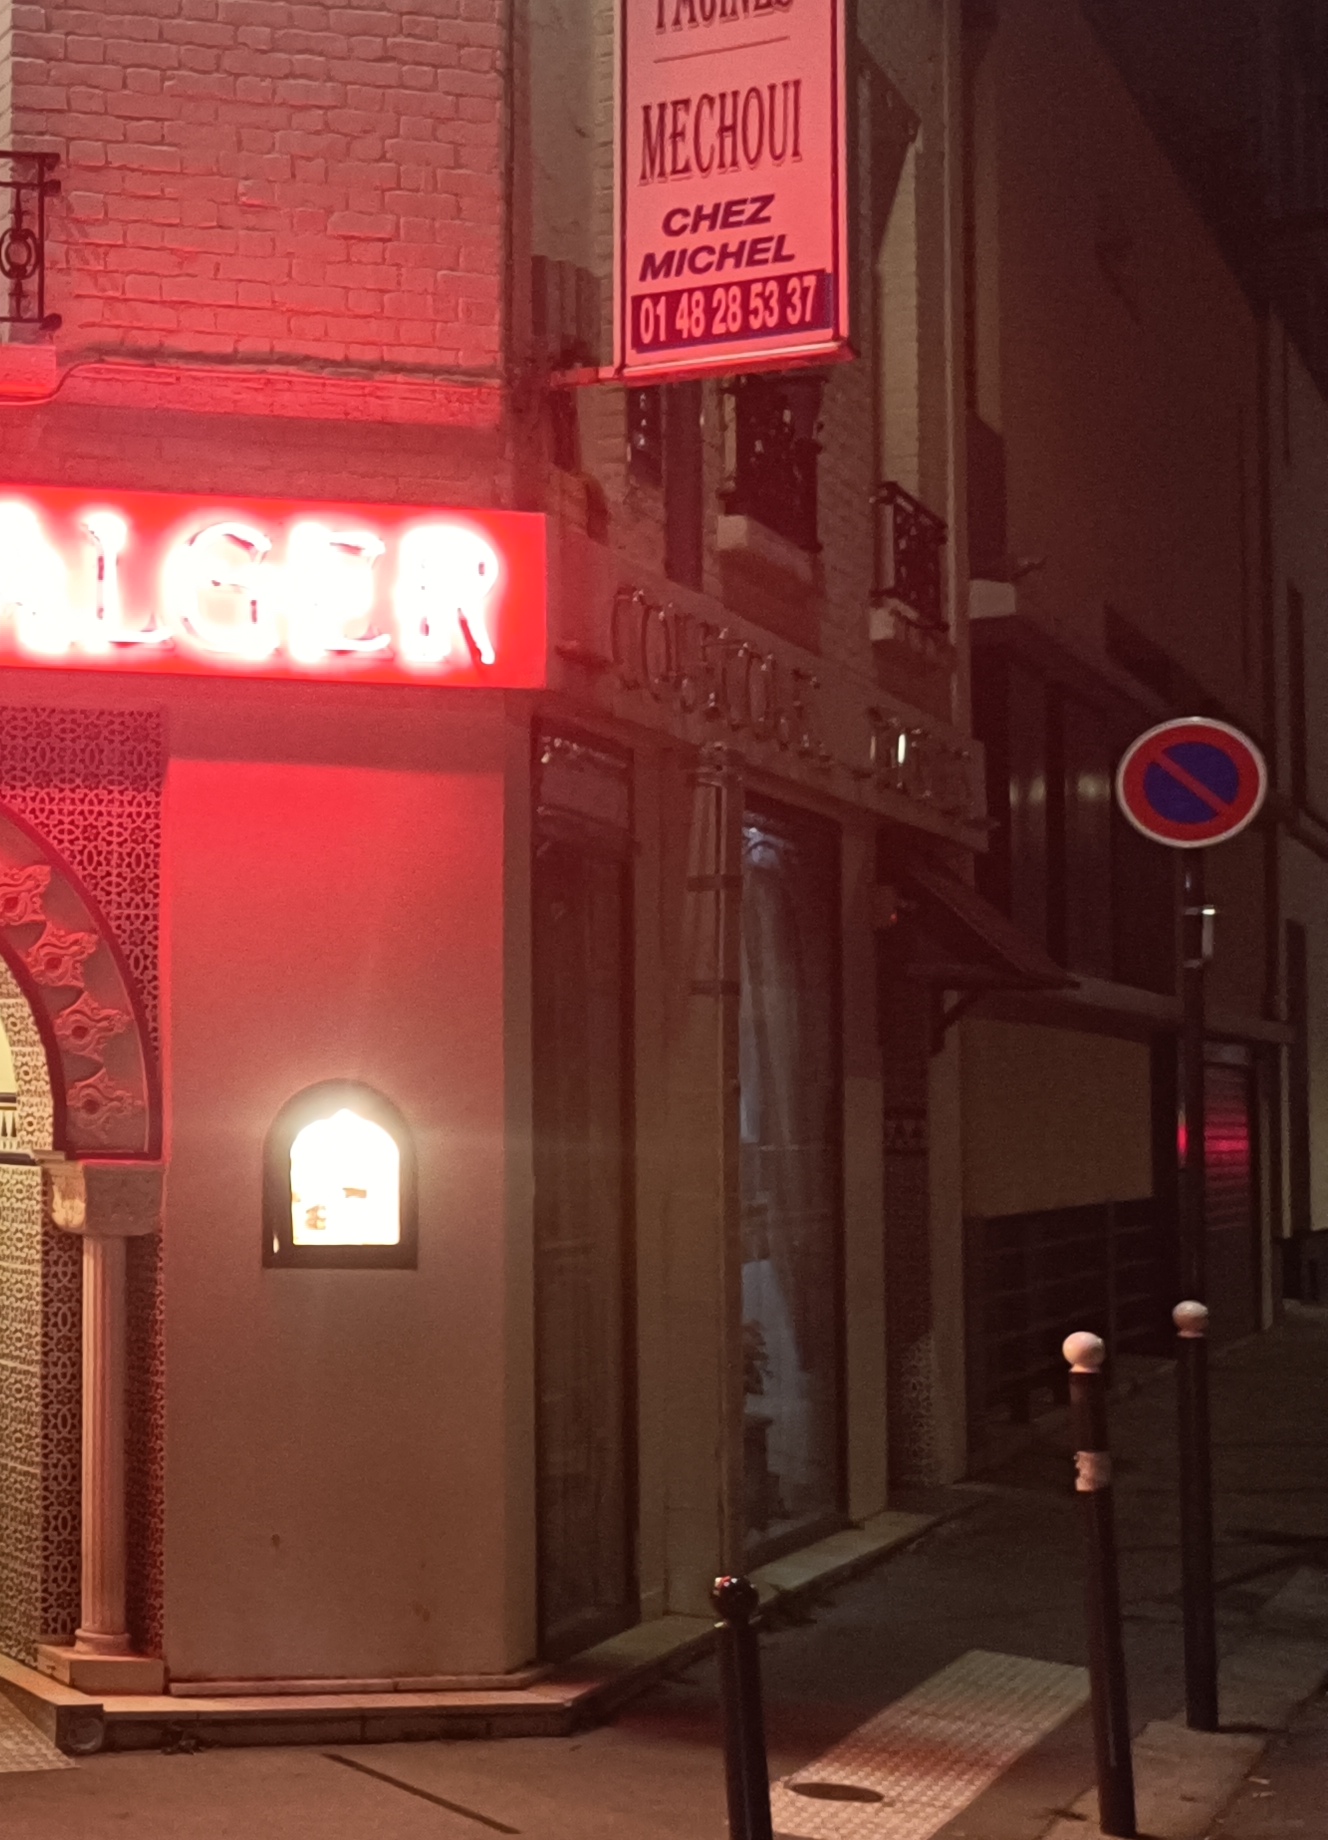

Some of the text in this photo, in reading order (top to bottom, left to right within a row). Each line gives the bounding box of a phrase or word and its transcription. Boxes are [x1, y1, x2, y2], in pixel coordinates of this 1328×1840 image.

[638, 78, 802, 184] MECHOUI
[662, 194, 775, 237] CHEZ
[639, 234, 795, 282] MICHEL
[640, 274, 817, 344] 01 48 28 53 37
